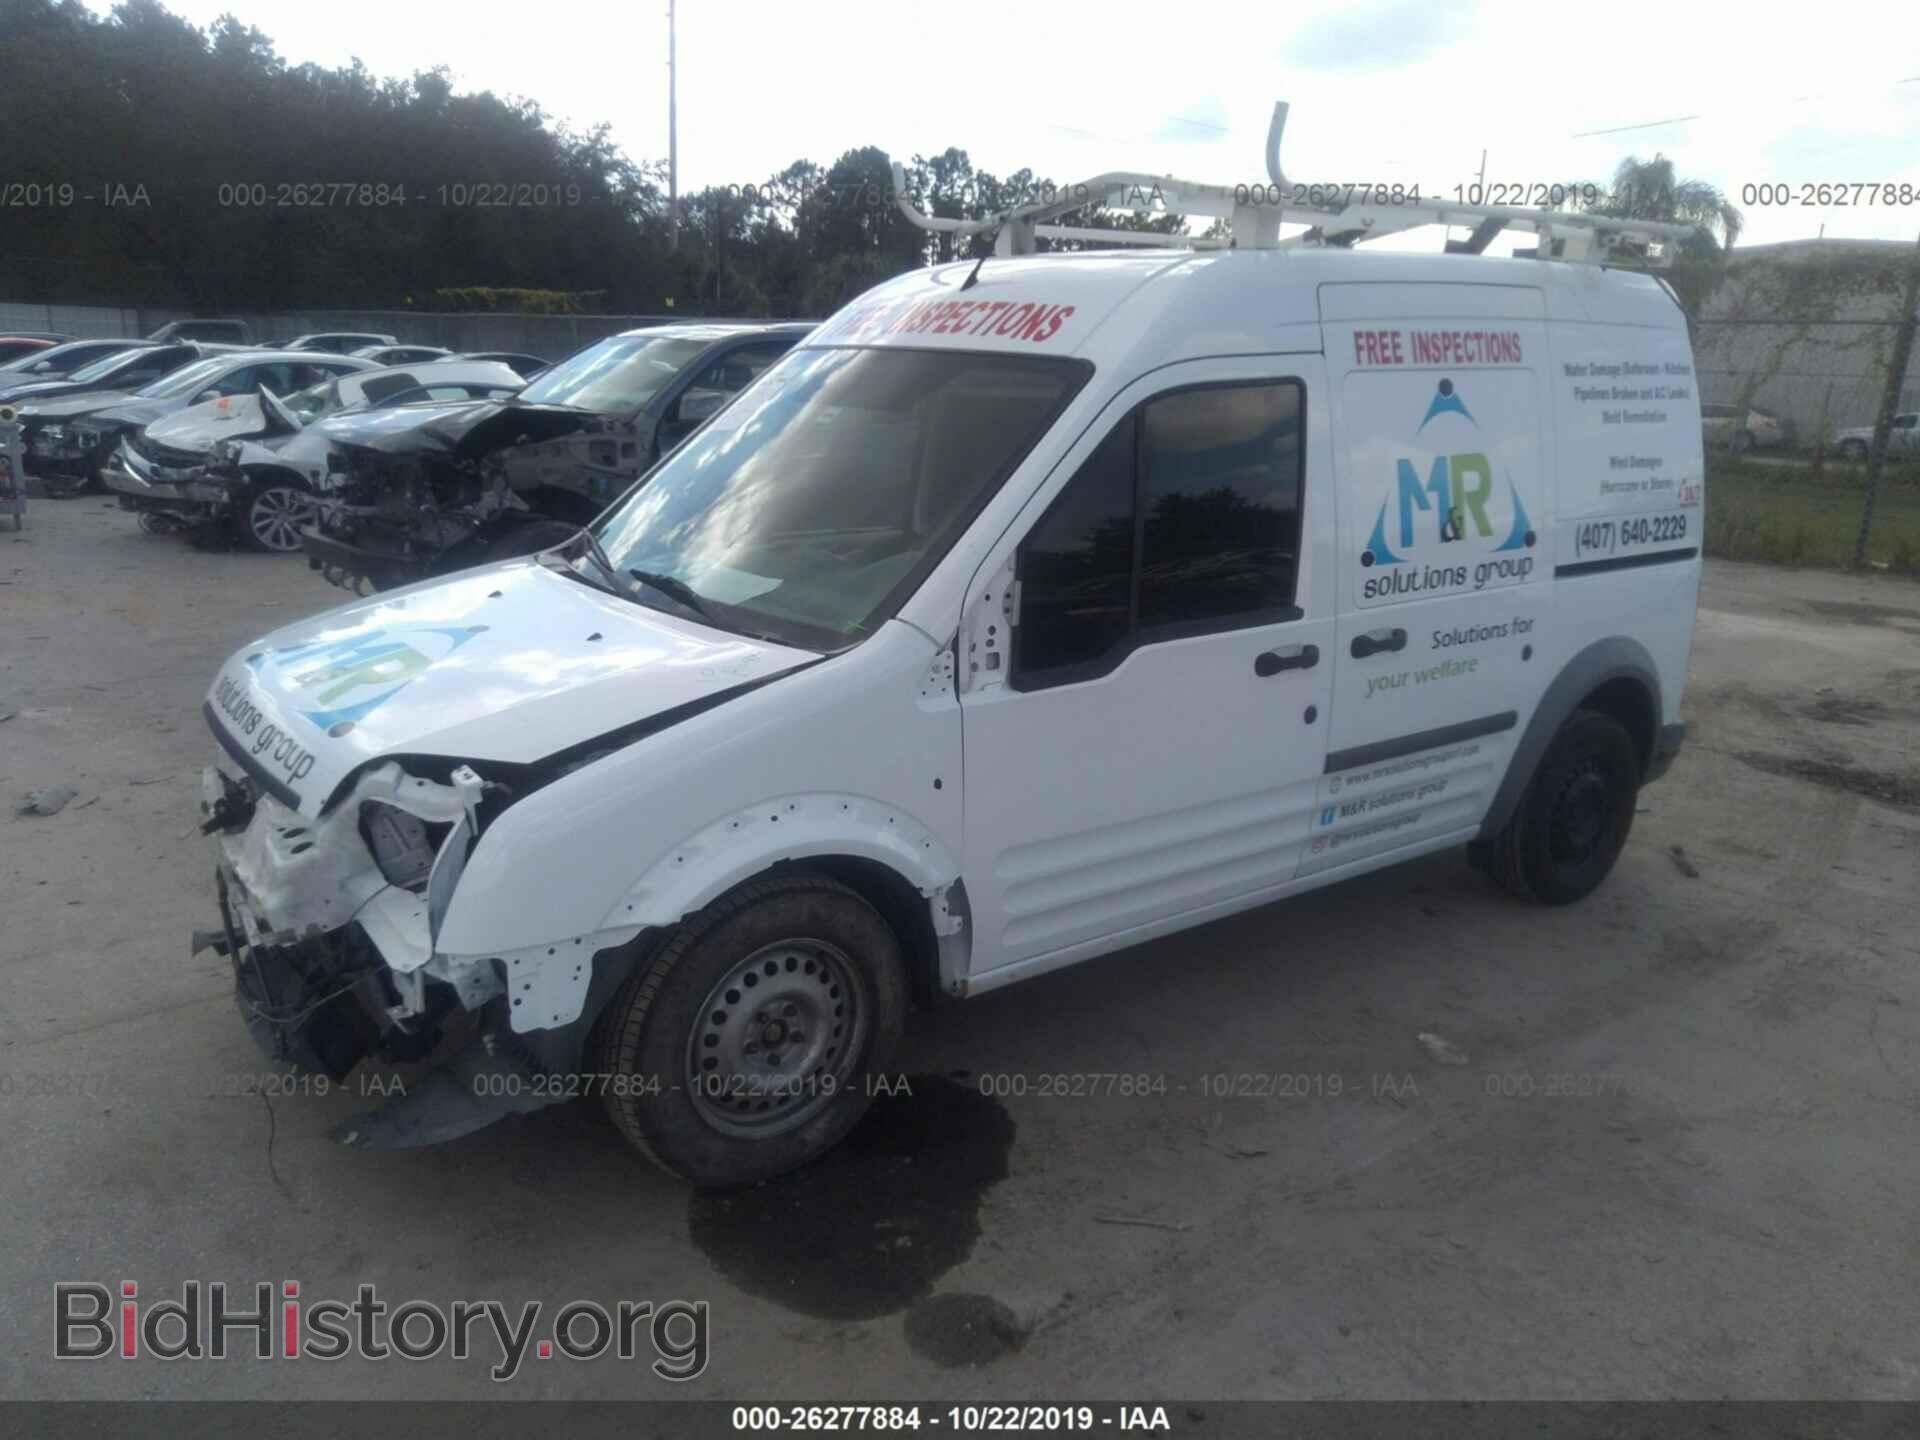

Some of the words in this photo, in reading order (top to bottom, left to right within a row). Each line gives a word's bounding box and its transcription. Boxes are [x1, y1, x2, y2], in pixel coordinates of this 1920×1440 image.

[887, 299, 1075, 343] INSPECTIONS
[1353, 330, 1405, 366] FREE
[1410, 330, 1523, 364] INSPECTIONS
[1397, 452, 1494, 550] M&R
[1575, 520, 1617, 558] (407)
[1621, 514, 1688, 547] 640-2229
[1363, 564, 1467, 599] solutions
[1474, 556, 1534, 590] group
[1431, 622, 1508, 650] Solutions
[1511, 616, 1536, 635] for
[1364, 670, 1411, 699] your
[1413, 656, 1479, 683] welfare
[252, 723, 316, 785] group
